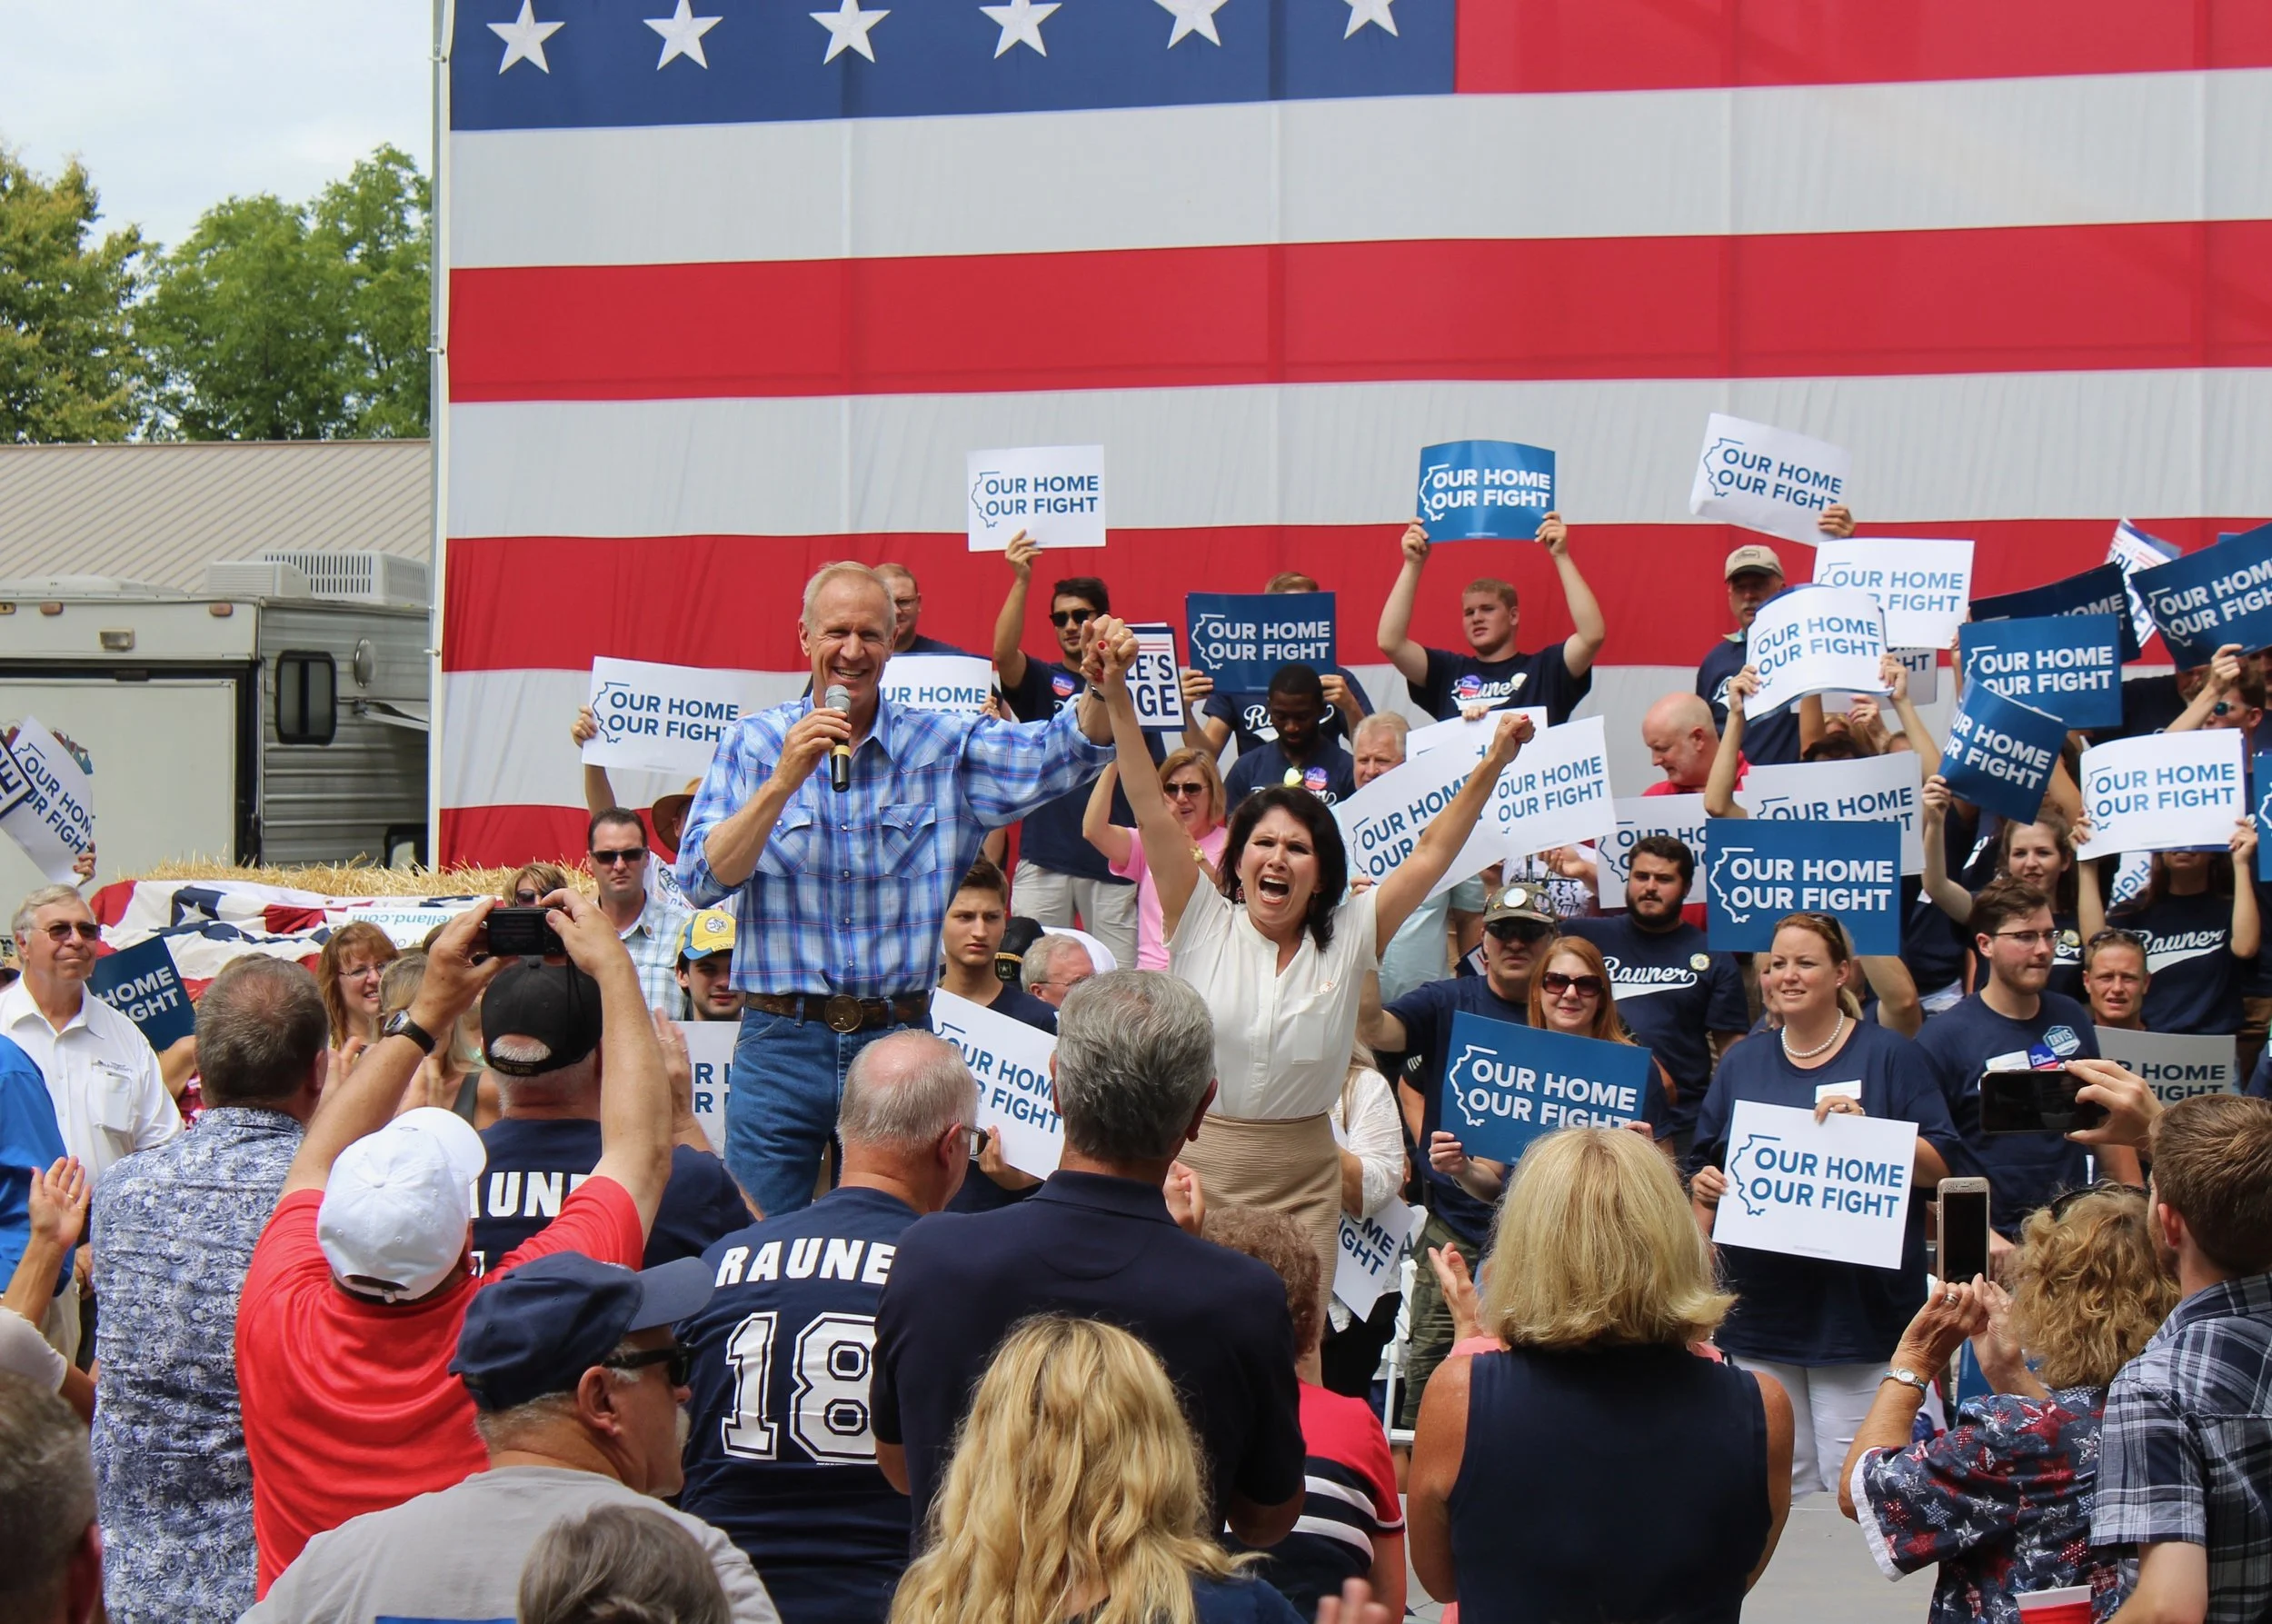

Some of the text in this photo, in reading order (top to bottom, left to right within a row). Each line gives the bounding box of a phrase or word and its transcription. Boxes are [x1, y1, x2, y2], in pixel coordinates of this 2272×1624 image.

[985, 475, 1099, 495] OUR HOME
[1432, 468, 1551, 490] OUR HOME
[1718, 469, 1767, 496] OUR
[1723, 448, 1843, 495] OUR HOME
[985, 497, 1098, 516] OUR FIGHT
[1430, 489, 1550, 510] OUR FIGHT
[1832, 571, 1964, 590] OUR HOME
[2159, 585, 2210, 615] OUR
[2211, 558, 2272, 600] HOM
[1888, 593, 1960, 613] FIGHT
[2170, 608, 2220, 637] OUR
[2220, 586, 2272, 622] FIGH
[1207, 621, 1330, 640] OUR HOME
[1758, 616, 1879, 655] OUR HOME
[1208, 642, 1330, 661] OUR FIGHT
[1759, 638, 1880, 675] OUR FIGHT
[1979, 645, 2113, 674] OUR HOME
[882, 686, 987, 704] UR HOME
[1982, 670, 2113, 697] OUR FIGHT
[610, 691, 739, 722] OUR HOME
[608, 713, 727, 743] OUR FIGH
[1953, 711, 2052, 771] UR HOME
[1498, 755, 1603, 800] OUR HOME
[1964, 746, 2044, 790] FIGHT
[2096, 762, 2236, 795] OUR HOME
[25, 756, 92, 839] OUR HOM
[25, 789, 48, 817] UR
[1498, 780, 1604, 823] OUR FIGHT
[1772, 787, 1914, 821] OUR HOME
[2096, 786, 2236, 818] OUR FIGHT
[1362, 811, 1407, 851] OUR
[1369, 837, 1414, 877] OUR
[1730, 857, 1794, 882] OUR
[1802, 859, 1894, 883] HOME
[1730, 886, 1892, 912] OUR FIGHT
[96, 966, 174, 1007] HOME
[1602, 955, 1698, 984] Rauner
[121, 987, 178, 1022] GHT
[950, 1038, 993, 1075] UR
[997, 1059, 1053, 1102] HOM
[1471, 1059, 1638, 1112] OUR HOME
[2142, 1064, 2227, 1081] HOME
[991, 1087, 1061, 1133] FIGHT
[1468, 1088, 1533, 1122] OUR
[1754, 1147, 1905, 1189] OUR HOME
[1750, 1177, 1900, 1218] OUR FIGHT
[714, 1238, 897, 1288] RAUNE
[721, 1311, 880, 1462] 18
